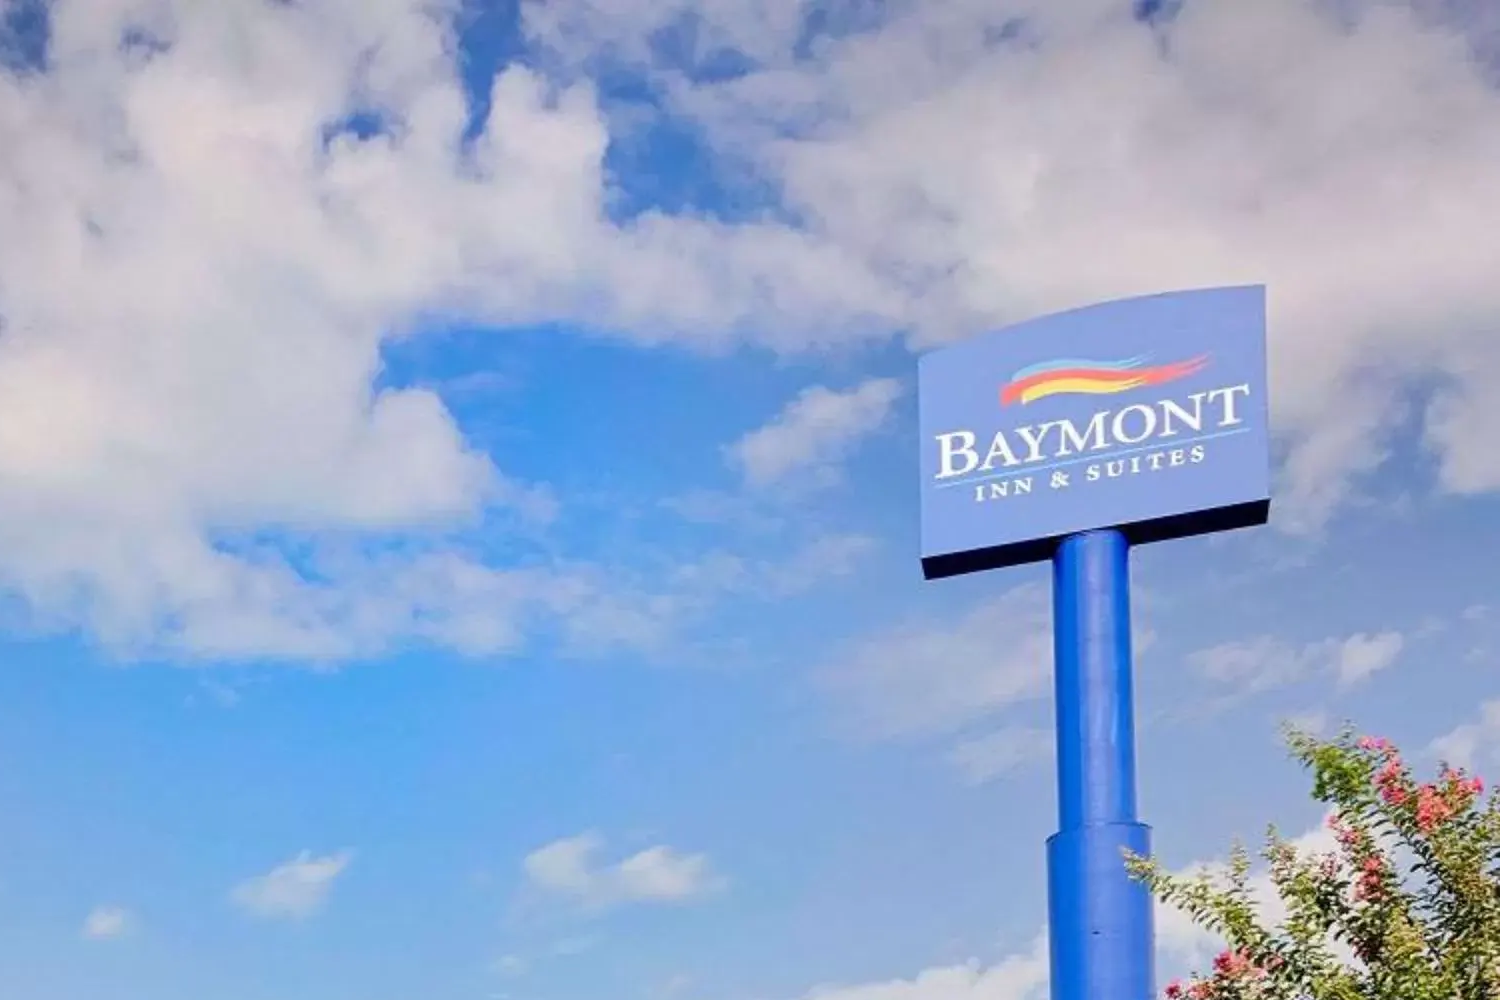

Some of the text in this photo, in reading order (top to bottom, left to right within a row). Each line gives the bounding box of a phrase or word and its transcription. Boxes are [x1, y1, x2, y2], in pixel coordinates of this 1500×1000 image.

[934, 383, 1250, 479] BAYMONT
[975, 445, 1206, 502] INN & SUITES
